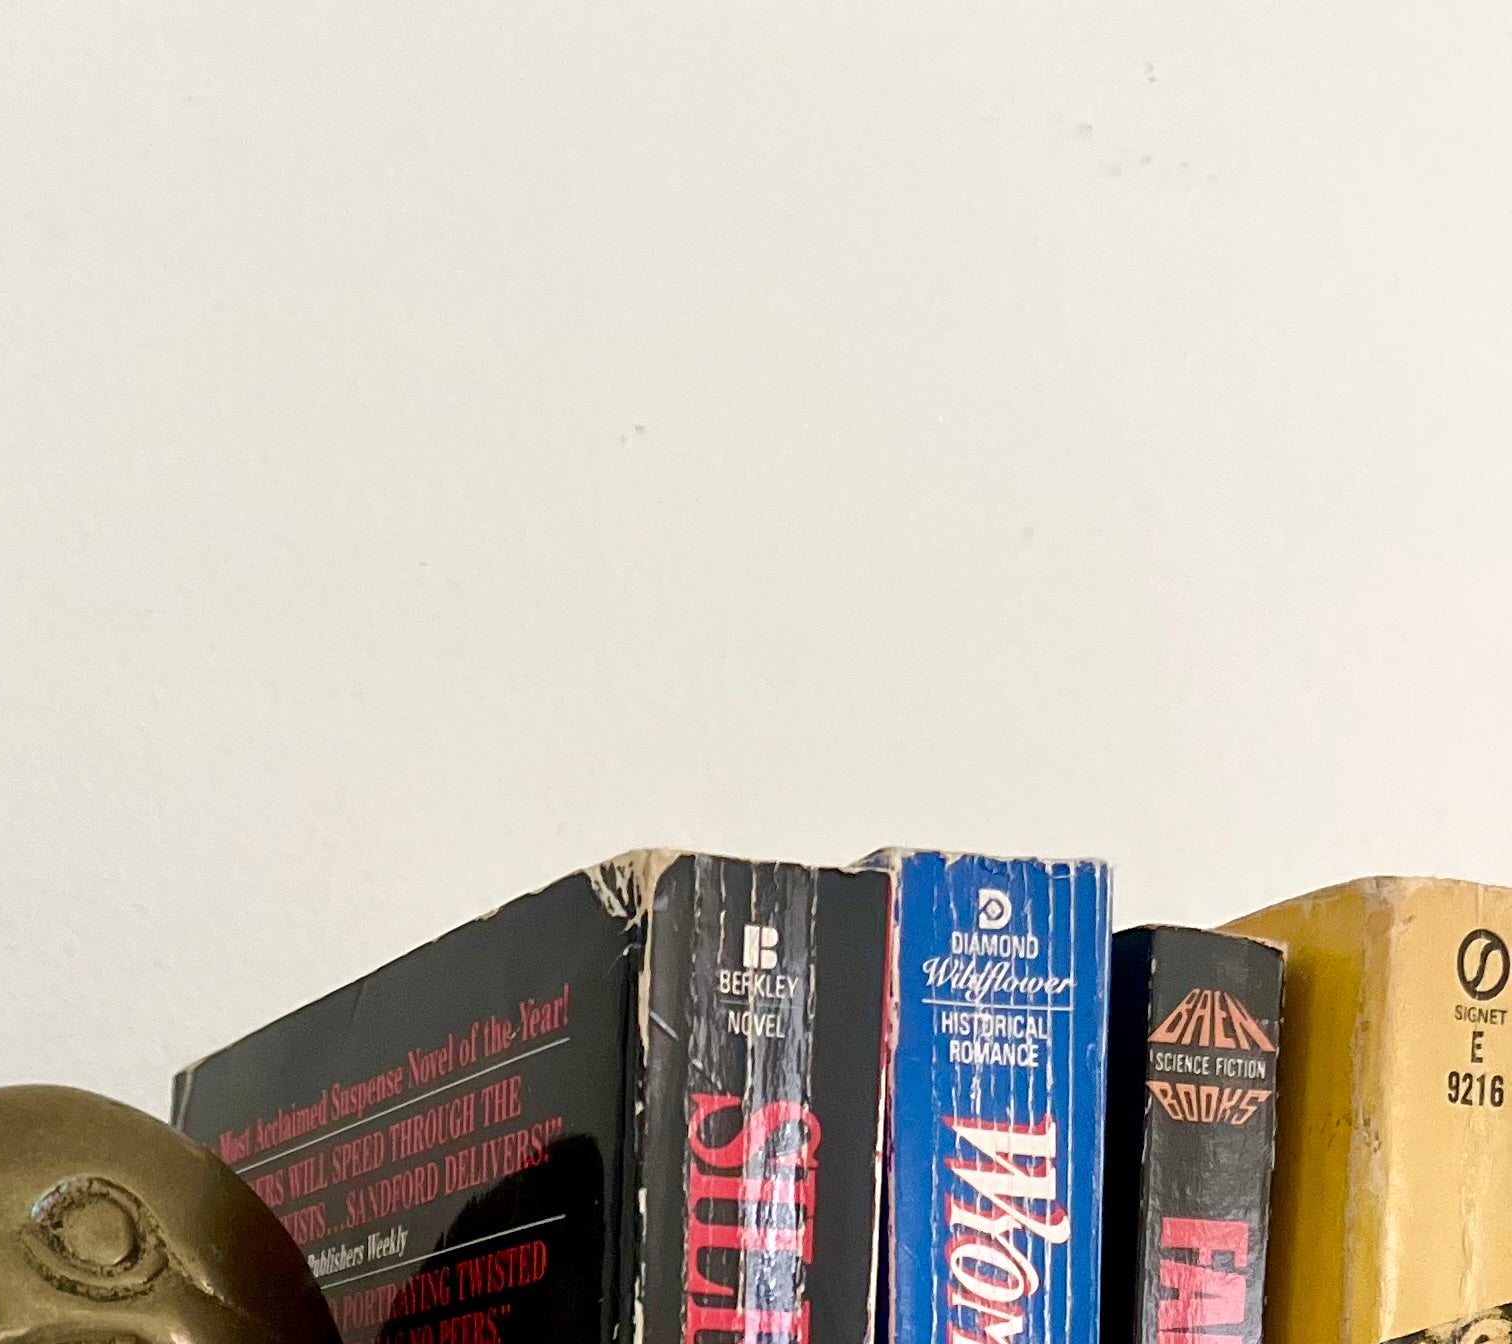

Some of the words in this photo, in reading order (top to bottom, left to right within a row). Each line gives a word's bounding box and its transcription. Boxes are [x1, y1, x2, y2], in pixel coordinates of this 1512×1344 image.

[951, 931, 1039, 959] DIAMOND
[719, 970, 800, 998] BERKLEY
[922, 956, 1075, 1002] Wildflower
[727, 1010, 785, 1039] NOVEL
[941, 1011, 1049, 1040] HISTORICAL
[1146, 987, 1277, 1053] BAEN
[1454, 1004, 1508, 1026] SIGNET
[949, 1040, 1039, 1068] ROMANCE
[1470, 1031, 1484, 1063] E
[219, 1127, 251, 1165] Most
[255, 1089, 327, 1150] Acclaimed
[330, 1066, 403, 1120] Suspense
[408, 1032, 453, 1088] Novel
[459, 1021, 480, 1067] of
[484, 1015, 512, 1057] the
[520, 983, 571, 1041] Year!
[1155, 1052, 1210, 1076] SCIENCE
[1215, 1056, 1266, 1079] FICTION
[1145, 1080, 1273, 1125] BOOKS
[1447, 1071, 1505, 1107] 9216
[251, 1169, 284, 1208] ERS
[288, 1152, 328, 1199] WILL
[331, 1131, 385, 1184] SPEED
[389, 1093, 475, 1162] THROUGH
[481, 1074, 523, 1128] THE
[367, 1225, 409, 1263] Weekly
[342, 1266, 451, 1331] PORTRAYING
[456, 1239, 549, 1302] TWISTED
